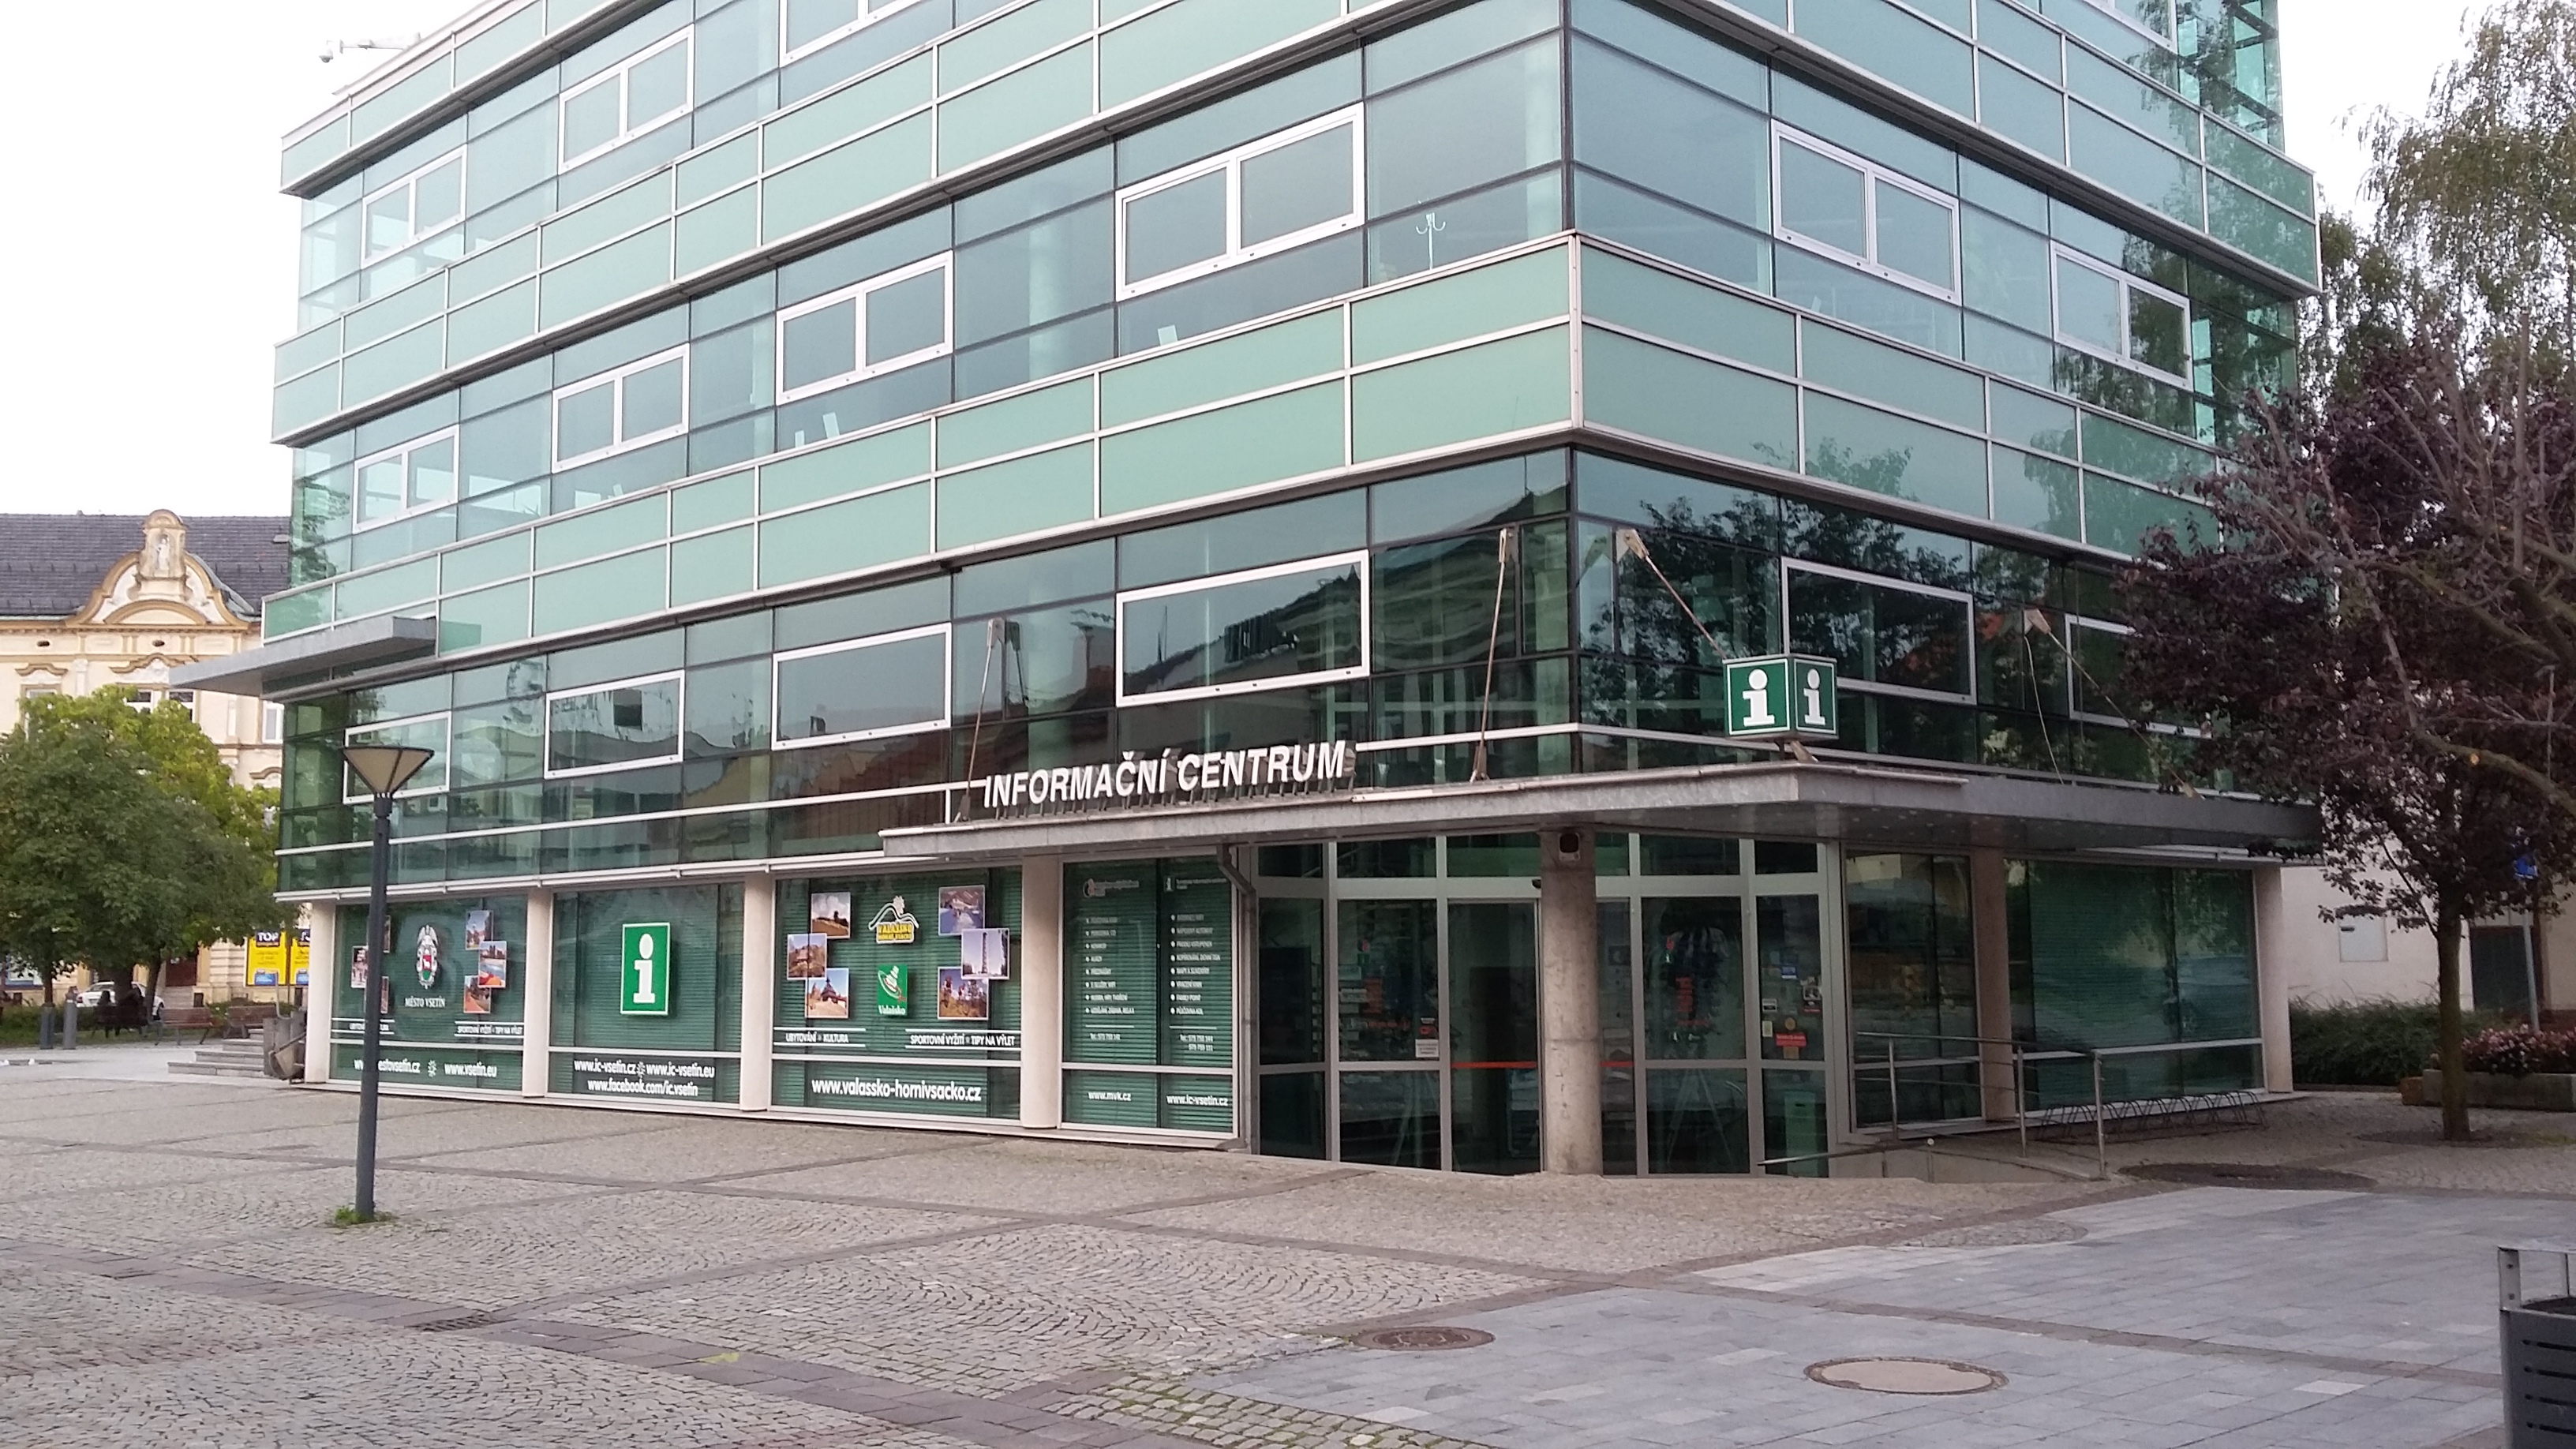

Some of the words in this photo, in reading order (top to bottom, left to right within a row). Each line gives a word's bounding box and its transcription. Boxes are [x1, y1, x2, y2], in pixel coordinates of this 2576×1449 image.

[983, 749, 1169, 808] INFORMAČNÍ
[1178, 740, 1346, 791] CENTRUM
[405, 997, 425, 1008] MĚSTO
[425, 996, 446, 1008] VSETÍN
[785, 1031, 817, 1043] UBYTOVÁNÍ
[823, 1034, 848, 1043] KULTURA
[910, 1032, 945, 1045] SPORTOVNÍ
[945, 1033, 964, 1045] VYŽITÍ
[971, 1035, 985, 1046] TIPY
[986, 1035, 995, 1046] NA
[996, 1034, 1015, 1046] VÝLET
[444, 1061, 497, 1078] www.vsetin.eu
[574, 1058, 636, 1075] www.ic-vsetin.cz
[646, 1061, 715, 1078] www.ic-vsetin.eu
[811, 1076, 982, 1102] www.valassko-hornivsacko.cz
[1088, 1091, 1132, 1102] www.mvk.cz
[1166, 1094, 1229, 1106] www.ic-vsetin.cz
